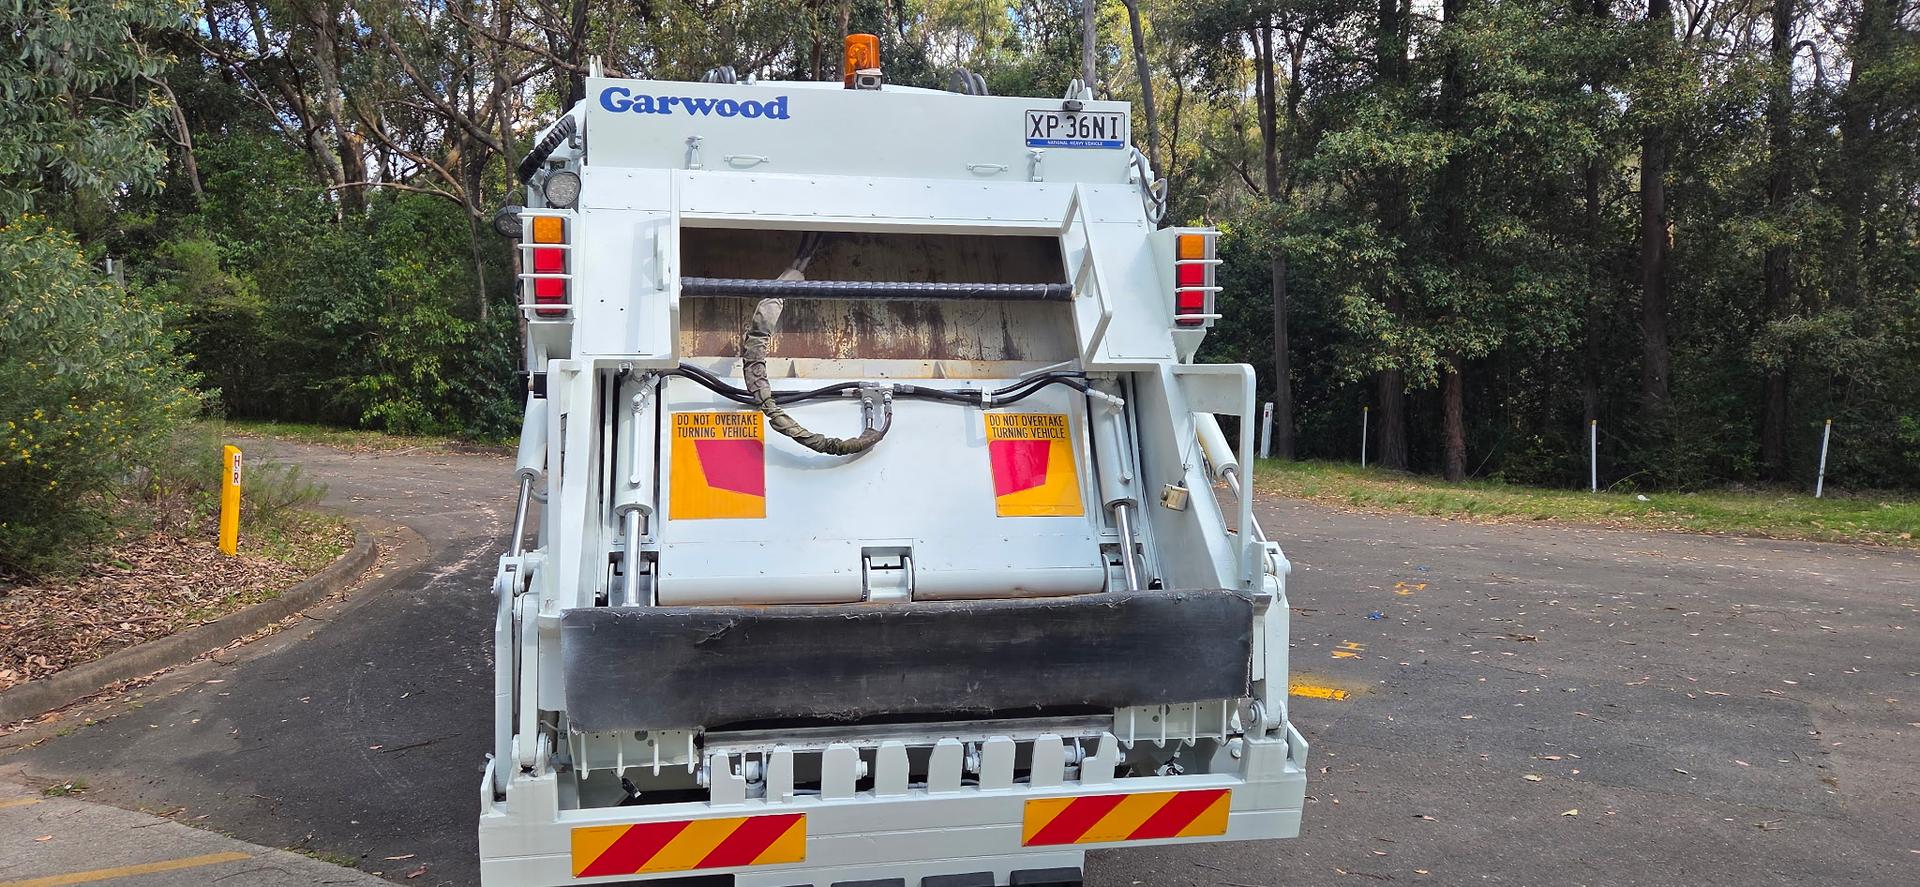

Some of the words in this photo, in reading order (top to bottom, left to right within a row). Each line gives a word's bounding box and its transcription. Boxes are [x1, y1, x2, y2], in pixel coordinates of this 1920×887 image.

[600, 86, 790, 120] Garwood
[677, 415, 689, 425] DO
[693, 415, 710, 425] NOT
[715, 415, 758, 425] OVERTAKE
[989, 415, 1000, 426] DO
[1003, 415, 1019, 426] NOT
[1021, 415, 1064, 427] OVERTAKE
[678, 427, 716, 438] TURNING
[722, 427, 758, 438] VEHICLE
[991, 427, 1028, 438] TURNING
[1030, 427, 1065, 438] VEHICLE
